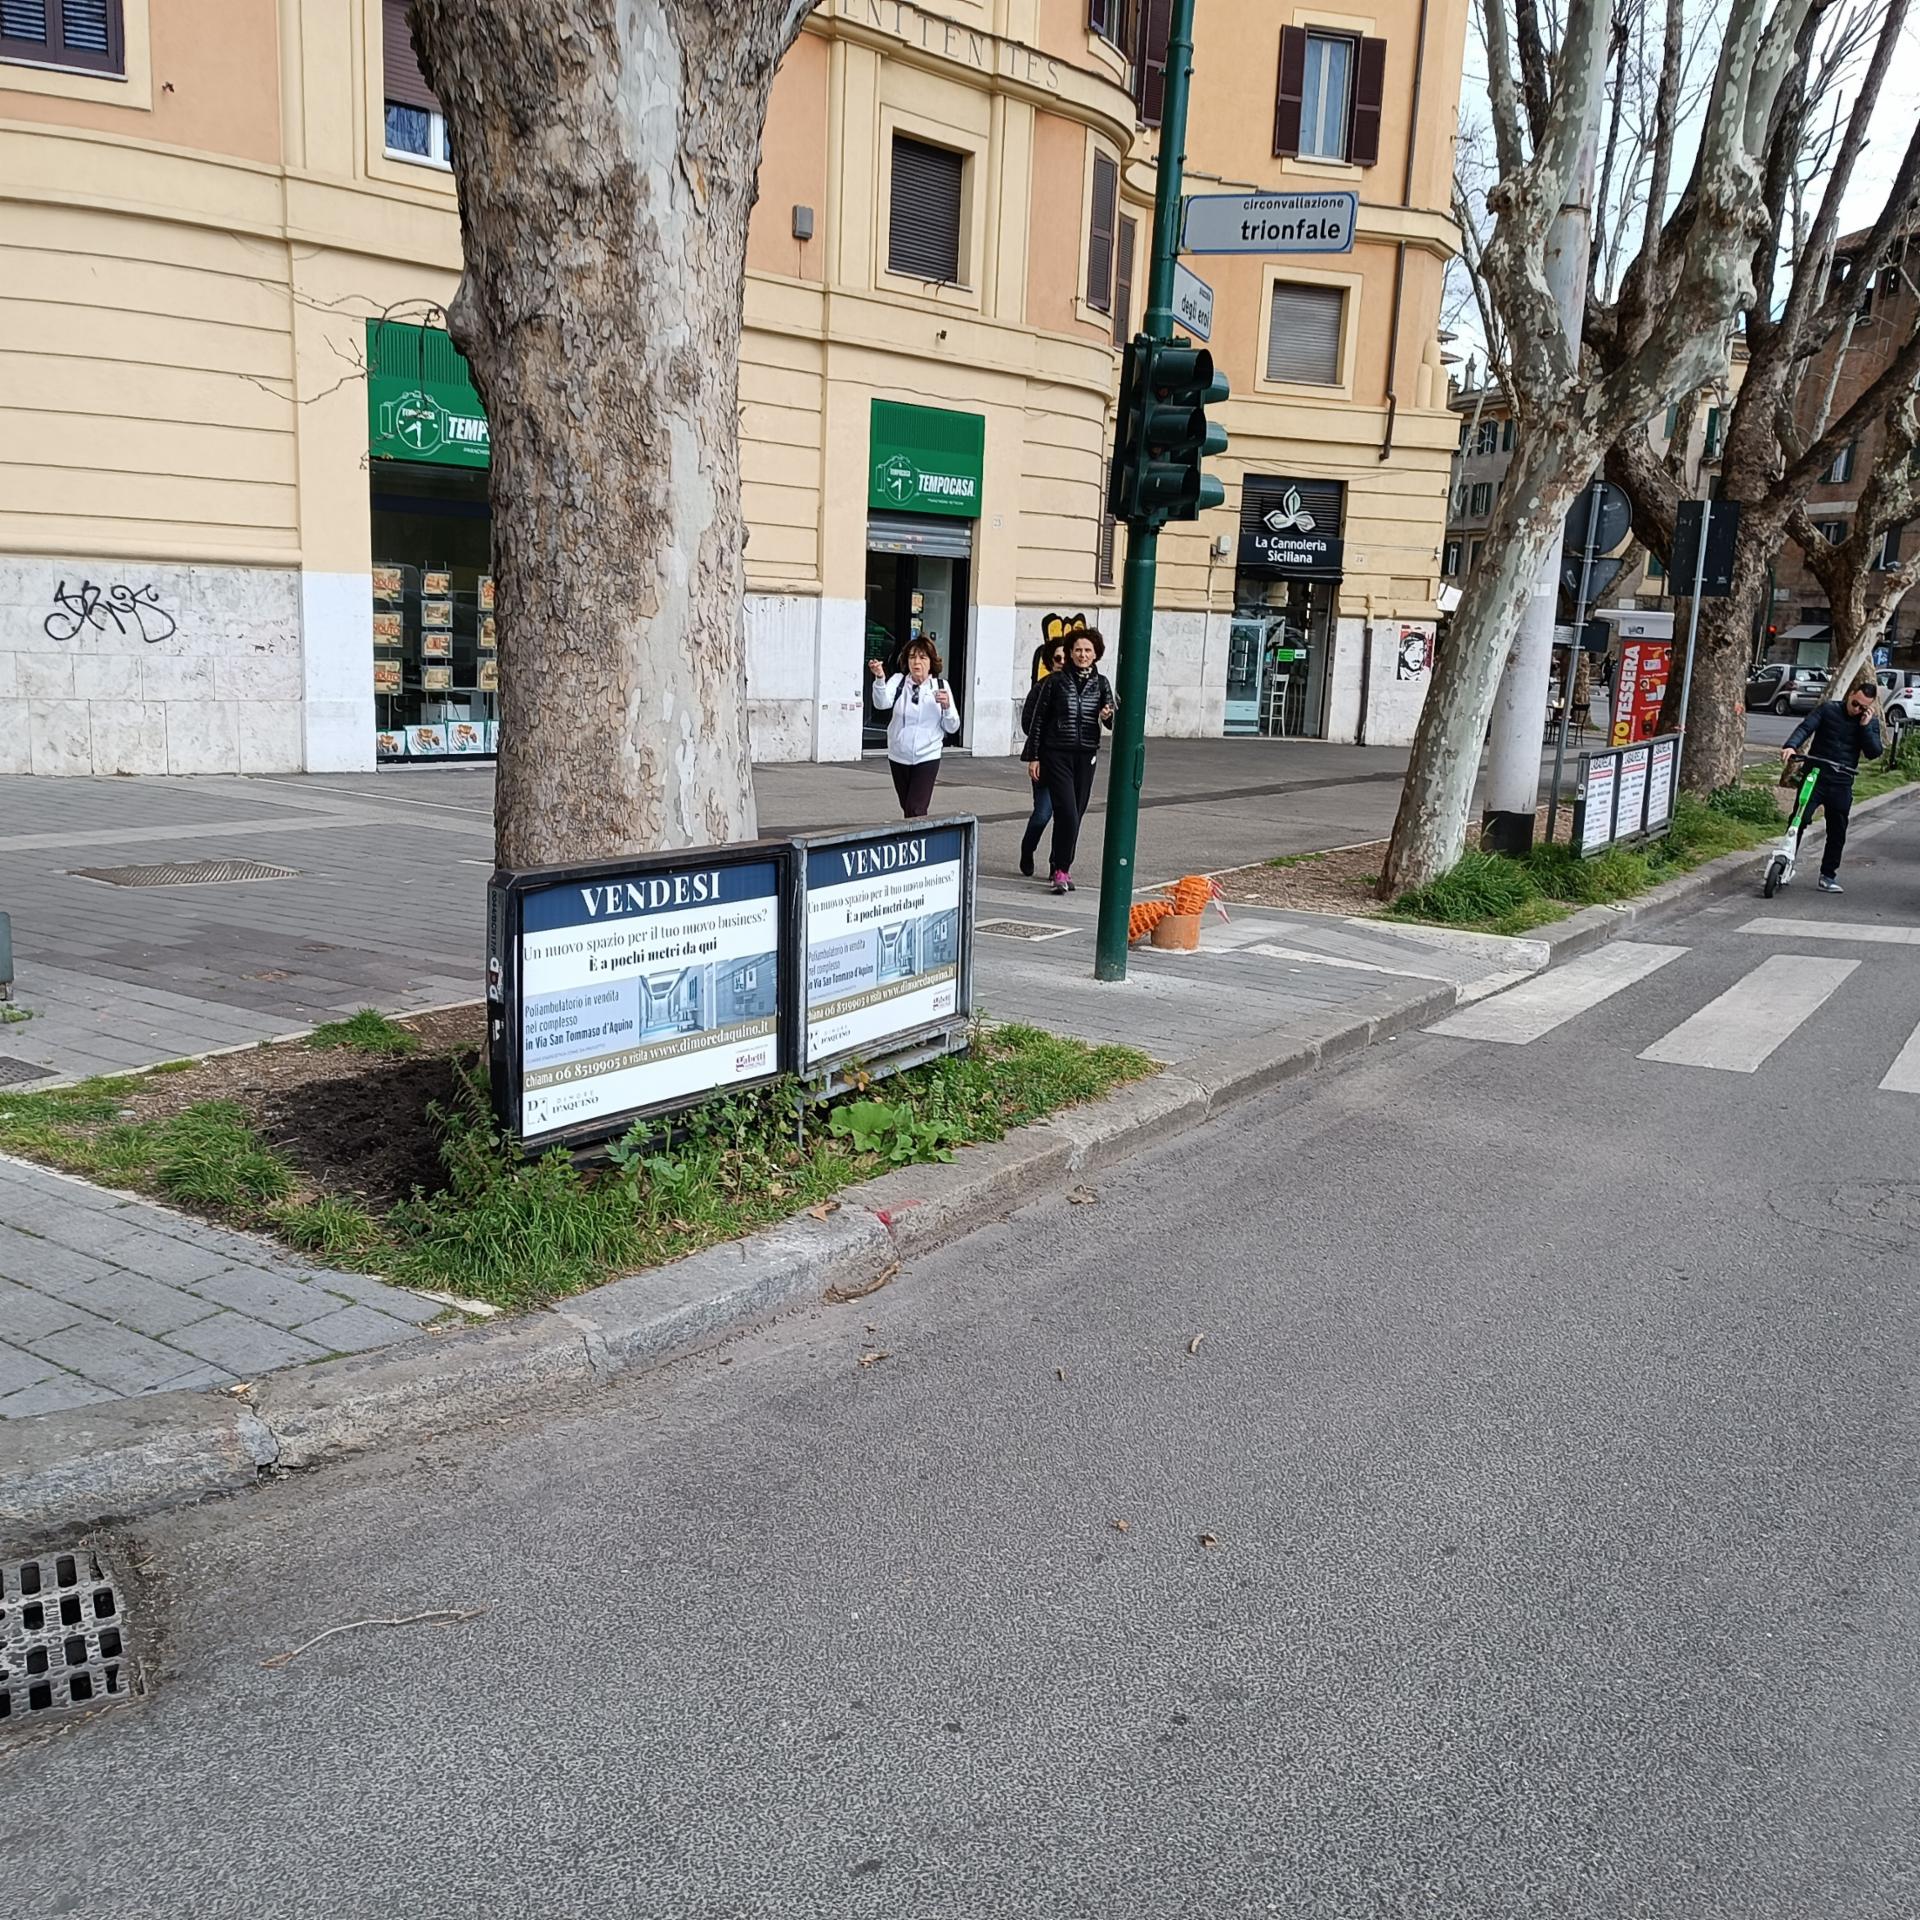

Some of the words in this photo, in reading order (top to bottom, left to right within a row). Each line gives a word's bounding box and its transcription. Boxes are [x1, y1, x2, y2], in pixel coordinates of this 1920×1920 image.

[1243, 197, 1344, 210] circonvallazione
[1241, 218, 1341, 241] trionfale
[1181, 293, 1197, 321] degli
[1197, 309, 1210, 329] eroi
[918, 474, 975, 497] TEMPOCASA
[1255, 536, 1268, 549] La
[1270, 537, 1327, 552] Cannoleria
[1267, 550, 1313, 564] Siciliana
[842, 839, 927, 877] VENDESI
[580, 871, 721, 917] VENDESI
[807, 902, 819, 914] Un
[844, 889, 869, 909] spazio
[870, 887, 882, 904] per
[884, 884, 890, 897] il
[924, 869, 955, 887] business?
[853, 912, 859, 922] a
[860, 902, 882, 923] pochi
[882, 898, 902, 916] metri
[523, 947, 542, 962] Un
[545, 941, 584, 957] nuovo
[587, 932, 625, 953] spazio
[628, 930, 648, 949] per
[650, 926, 658, 941] il
[661, 924, 680, 939] tuo
[683, 921, 716, 936] nuovo
[718, 908, 768, 930] business?
[589, 955, 598, 972] È
[600, 960, 608, 970] a
[611, 949, 645, 972] pochi
[648, 943, 680, 962] metri
[683, 939, 697, 955] da
[698, 937, 718, 958] qui
[813, 978, 822, 989] Via
[823, 976, 832, 987] San
[832, 969, 854, 984] Tommaso
[824, 1003, 836, 1017] 06
[882, 966, 954, 998] www.dimoredaquino.it
[525, 996, 583, 1018] Poliambulatorio
[585, 994, 592, 1007] in
[593, 989, 619, 1005] vendita
[525, 1022, 537, 1035] nel
[539, 1015, 578, 1032] complesso
[525, 1038, 533, 1051] in
[535, 1036, 548, 1049] Via
[549, 1033, 564, 1046] San
[565, 1026, 600, 1043] Tommaso
[602, 1019, 633, 1036] d'Aquino
[525, 1072, 553, 1089] chiama
[555, 1066, 572, 1081] 06
[622, 1055, 628, 1066] o
[629, 1049, 648, 1064] visita
[649, 1020, 769, 1059] www.dimoredaquino.it
[552, 1096, 600, 1114] D'AQUINO
